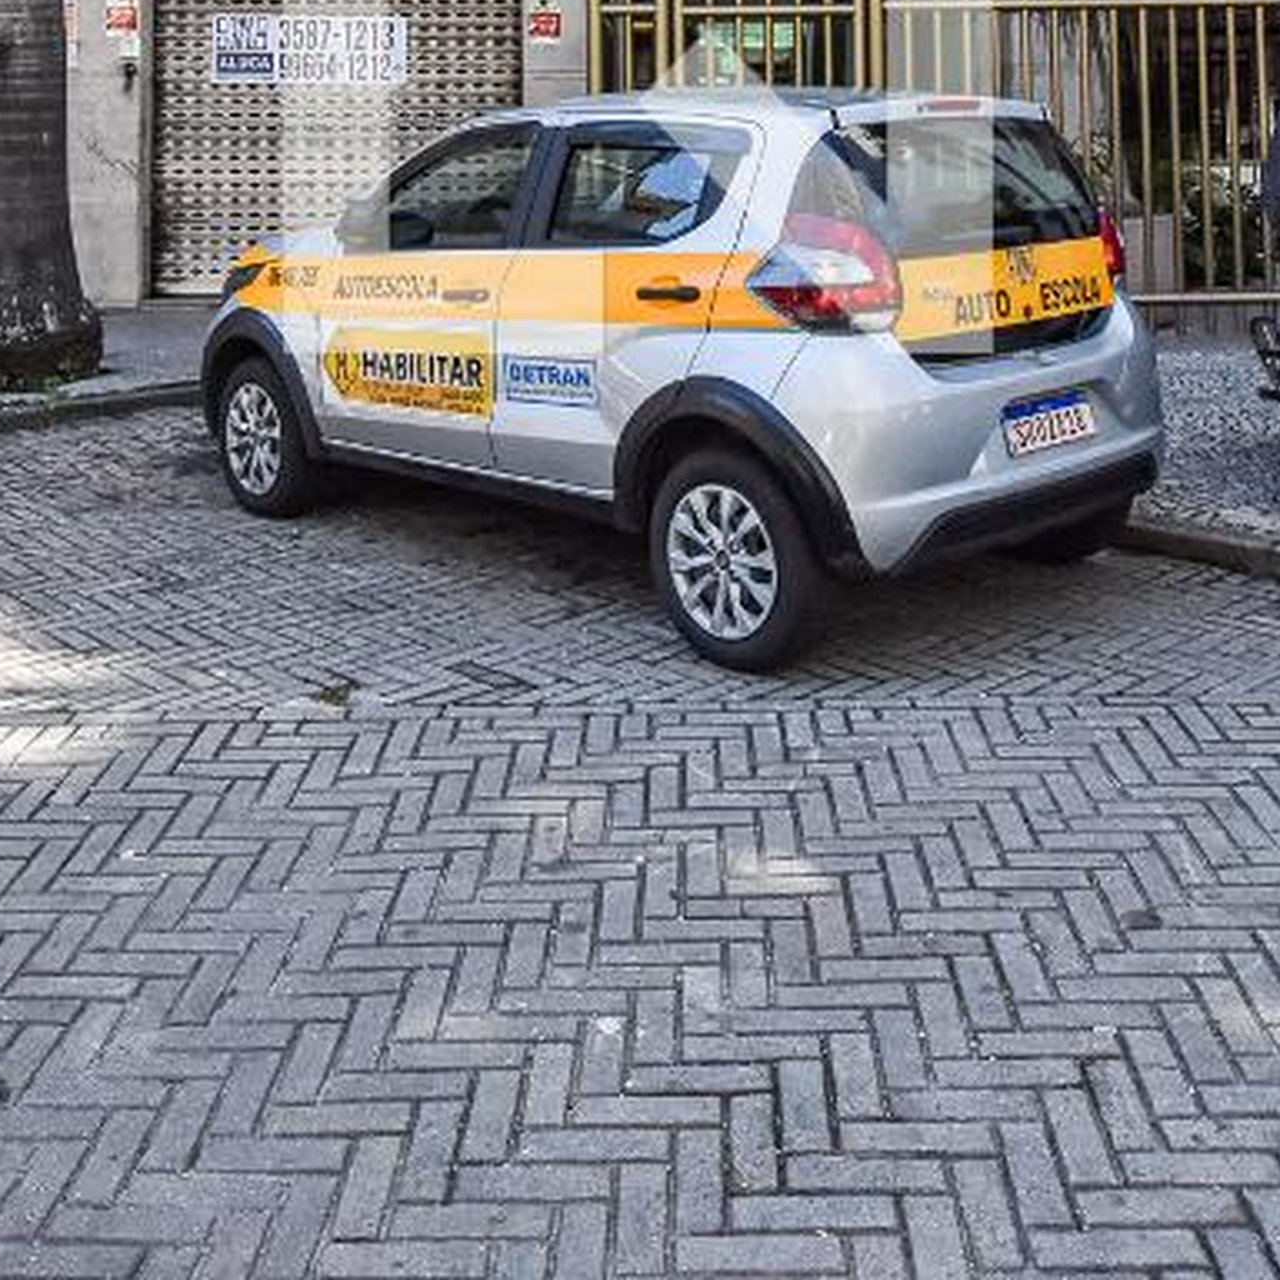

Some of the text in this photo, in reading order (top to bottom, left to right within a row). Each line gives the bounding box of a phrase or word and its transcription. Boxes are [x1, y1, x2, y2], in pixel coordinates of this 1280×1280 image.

[279, 18, 396, 51] 3587-1213
[954, 287, 1011, 325] AUTO
[1038, 274, 1102, 312] ESCOLA
[361, 349, 484, 388] HABILITAR
[509, 362, 592, 388] DETRAN
